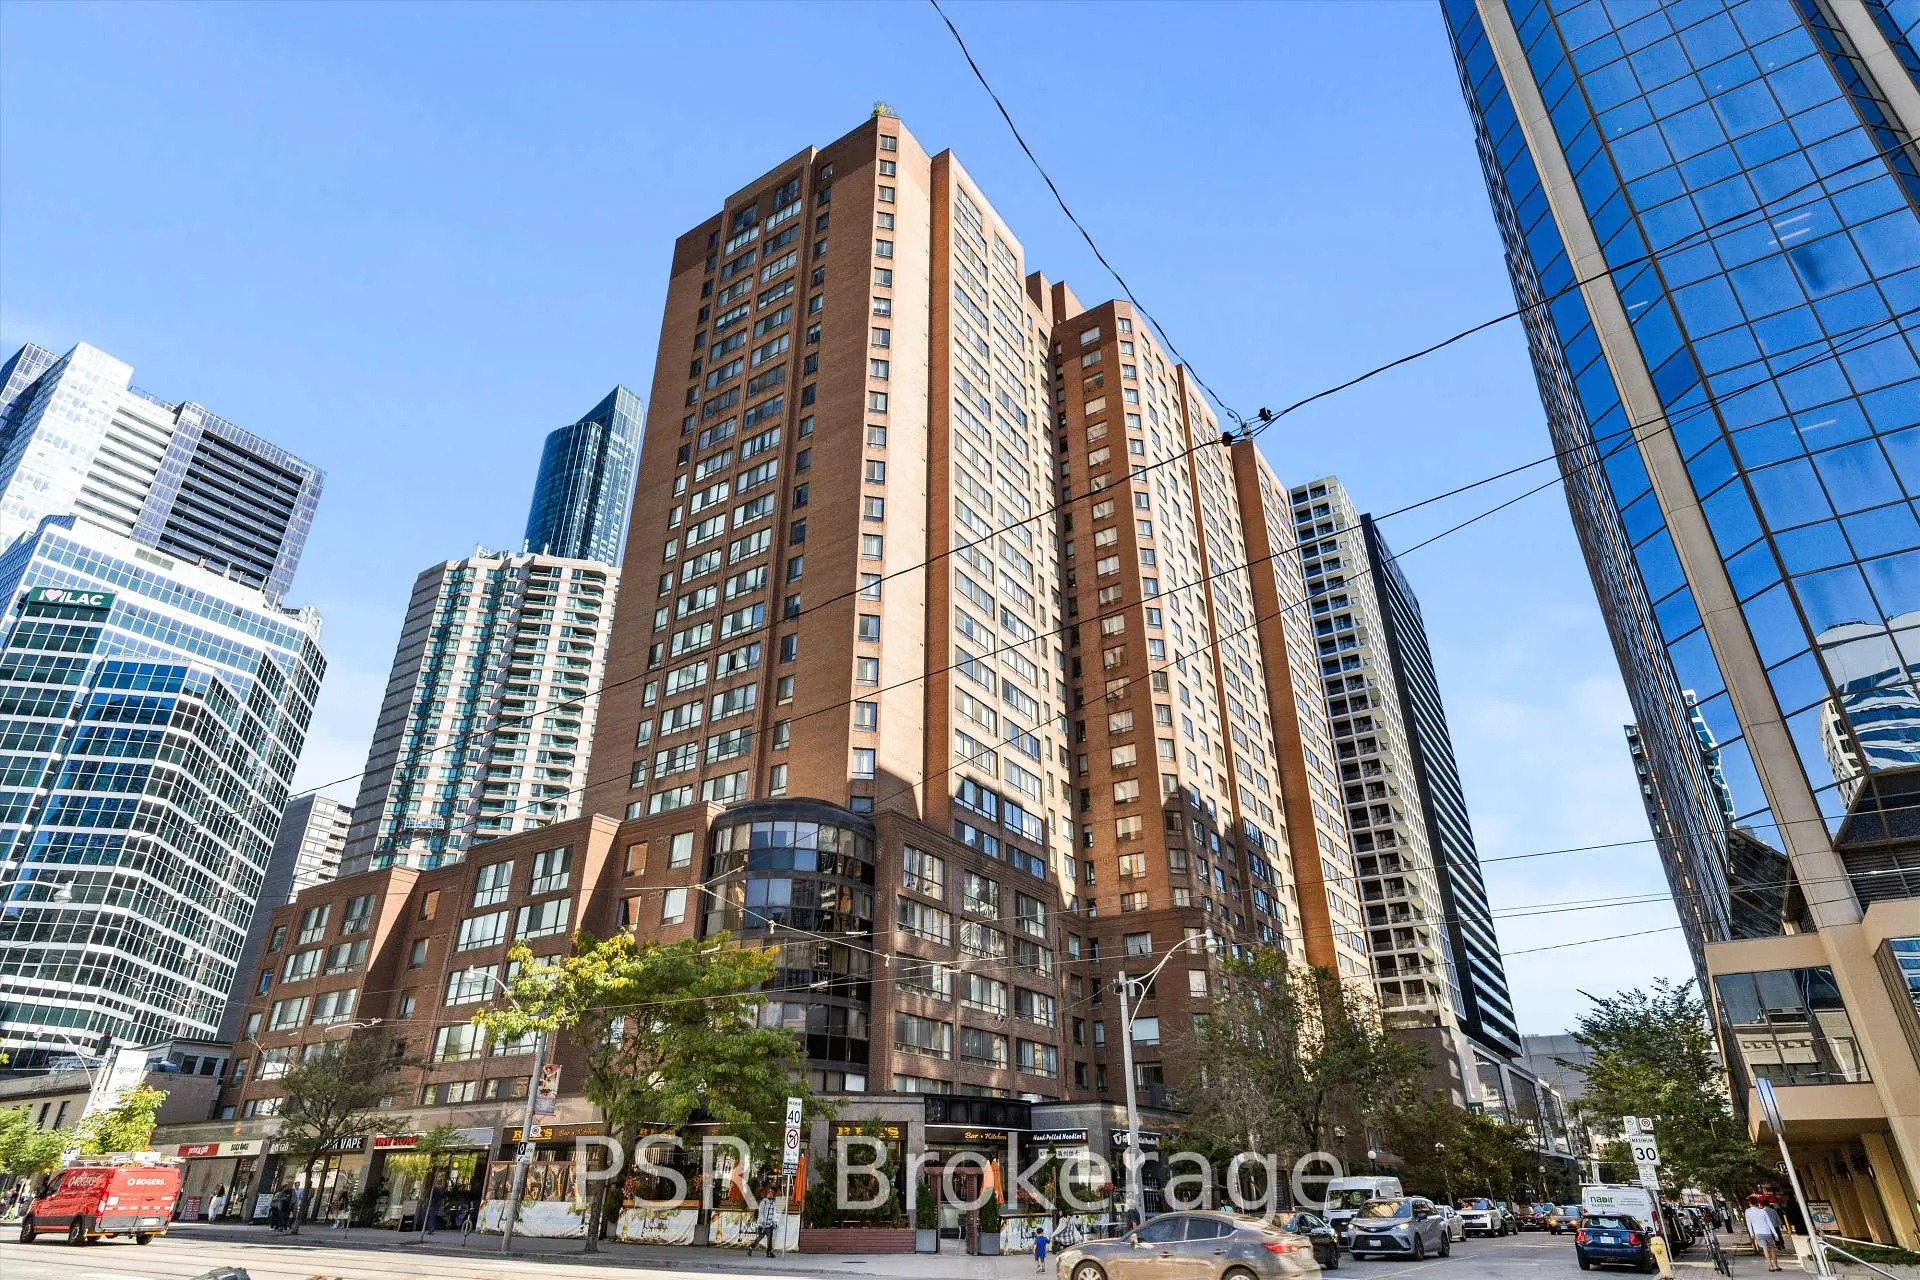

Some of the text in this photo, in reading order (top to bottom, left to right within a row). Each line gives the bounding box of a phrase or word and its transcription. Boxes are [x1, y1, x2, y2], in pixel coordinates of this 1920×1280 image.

[788, 1110, 800, 1123] 40
[964, 1131, 1007, 1140] Bar Kitchen
[1062, 1132, 1082, 1140] Noodles
[340, 1138, 362, 1149] VAPE
[1635, 1147, 1656, 1161] 30
[136, 1178, 165, 1186] ROGERS
